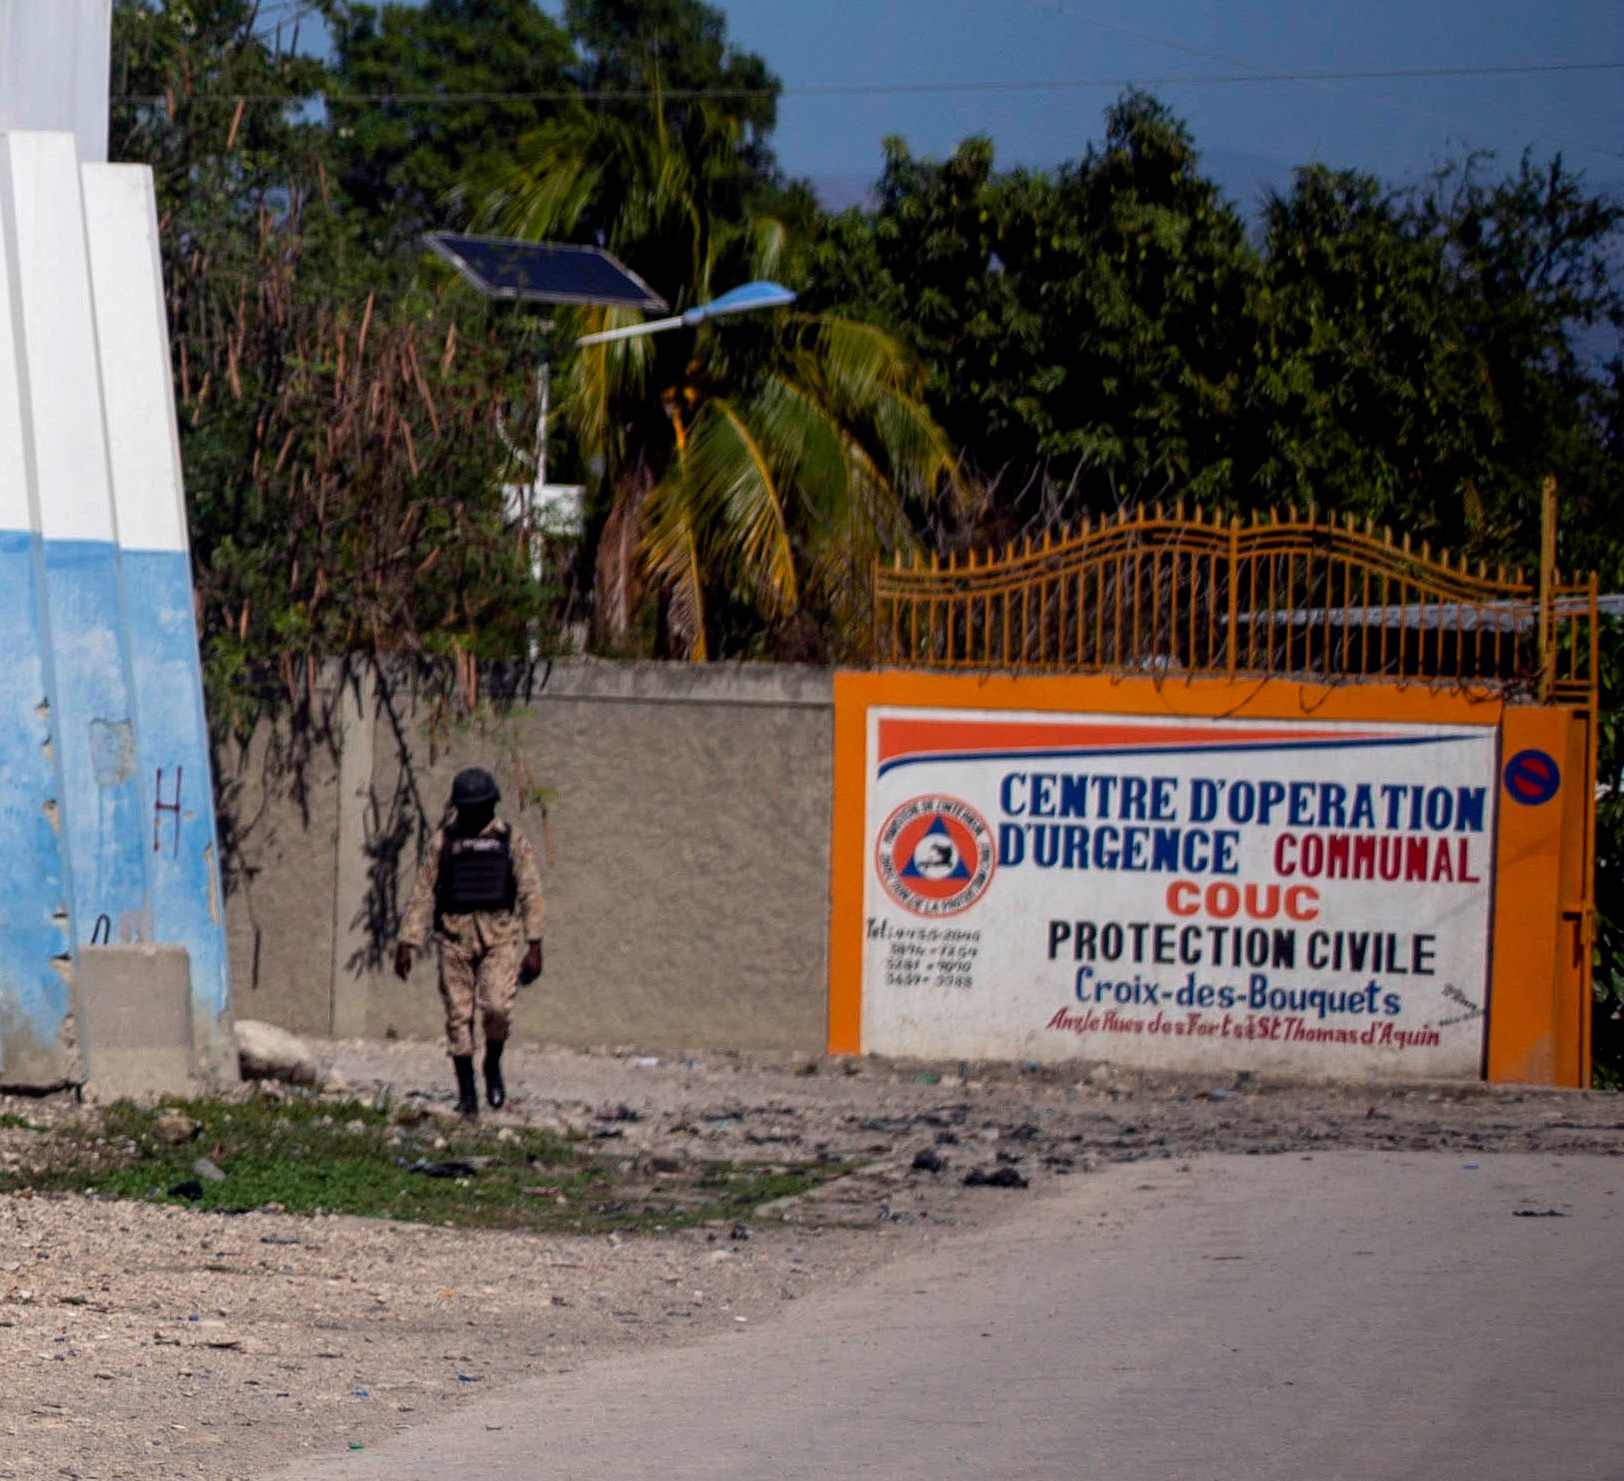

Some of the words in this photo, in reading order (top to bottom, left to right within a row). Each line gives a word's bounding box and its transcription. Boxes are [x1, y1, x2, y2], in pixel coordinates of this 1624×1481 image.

[999, 772, 1178, 821] CENTRE
[1189, 778, 1486, 832] D'OPERATION
[998, 822, 1240, 875] D'URGENCE
[1274, 832, 1480, 884] COMMUNAL
[1165, 879, 1320, 920] COUC
[1047, 919, 1295, 969] PROTECTION
[1307, 929, 1436, 976] CIVILE
[1075, 965, 1401, 1019] Croix-des-Bouquets
[1046, 1005, 1100, 1035] Angle
[1102, 1008, 1143, 1035] Rues
[1147, 1010, 1184, 1035] des
[1258, 1016, 1283, 1041] St
[1283, 1017, 1358, 1045] Thomas
[1360, 1020, 1441, 1050] d'Aquin
